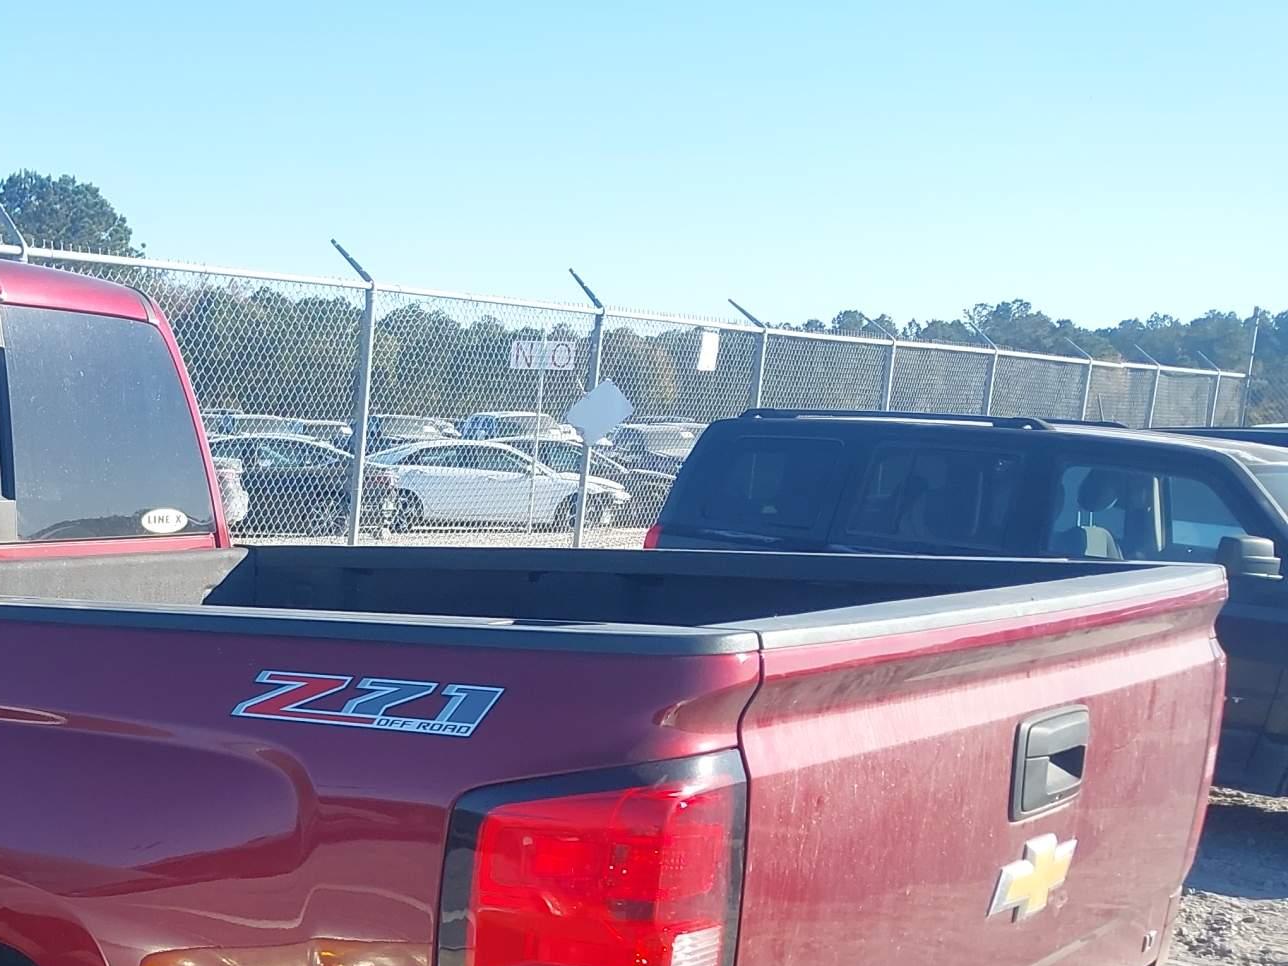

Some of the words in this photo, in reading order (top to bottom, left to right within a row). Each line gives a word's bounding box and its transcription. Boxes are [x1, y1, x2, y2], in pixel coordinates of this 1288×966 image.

[147, 515, 170, 524] LINE
[231, 670, 505, 728] Z71
[376, 717, 414, 729] OFF
[415, 721, 472, 735] ROAD
